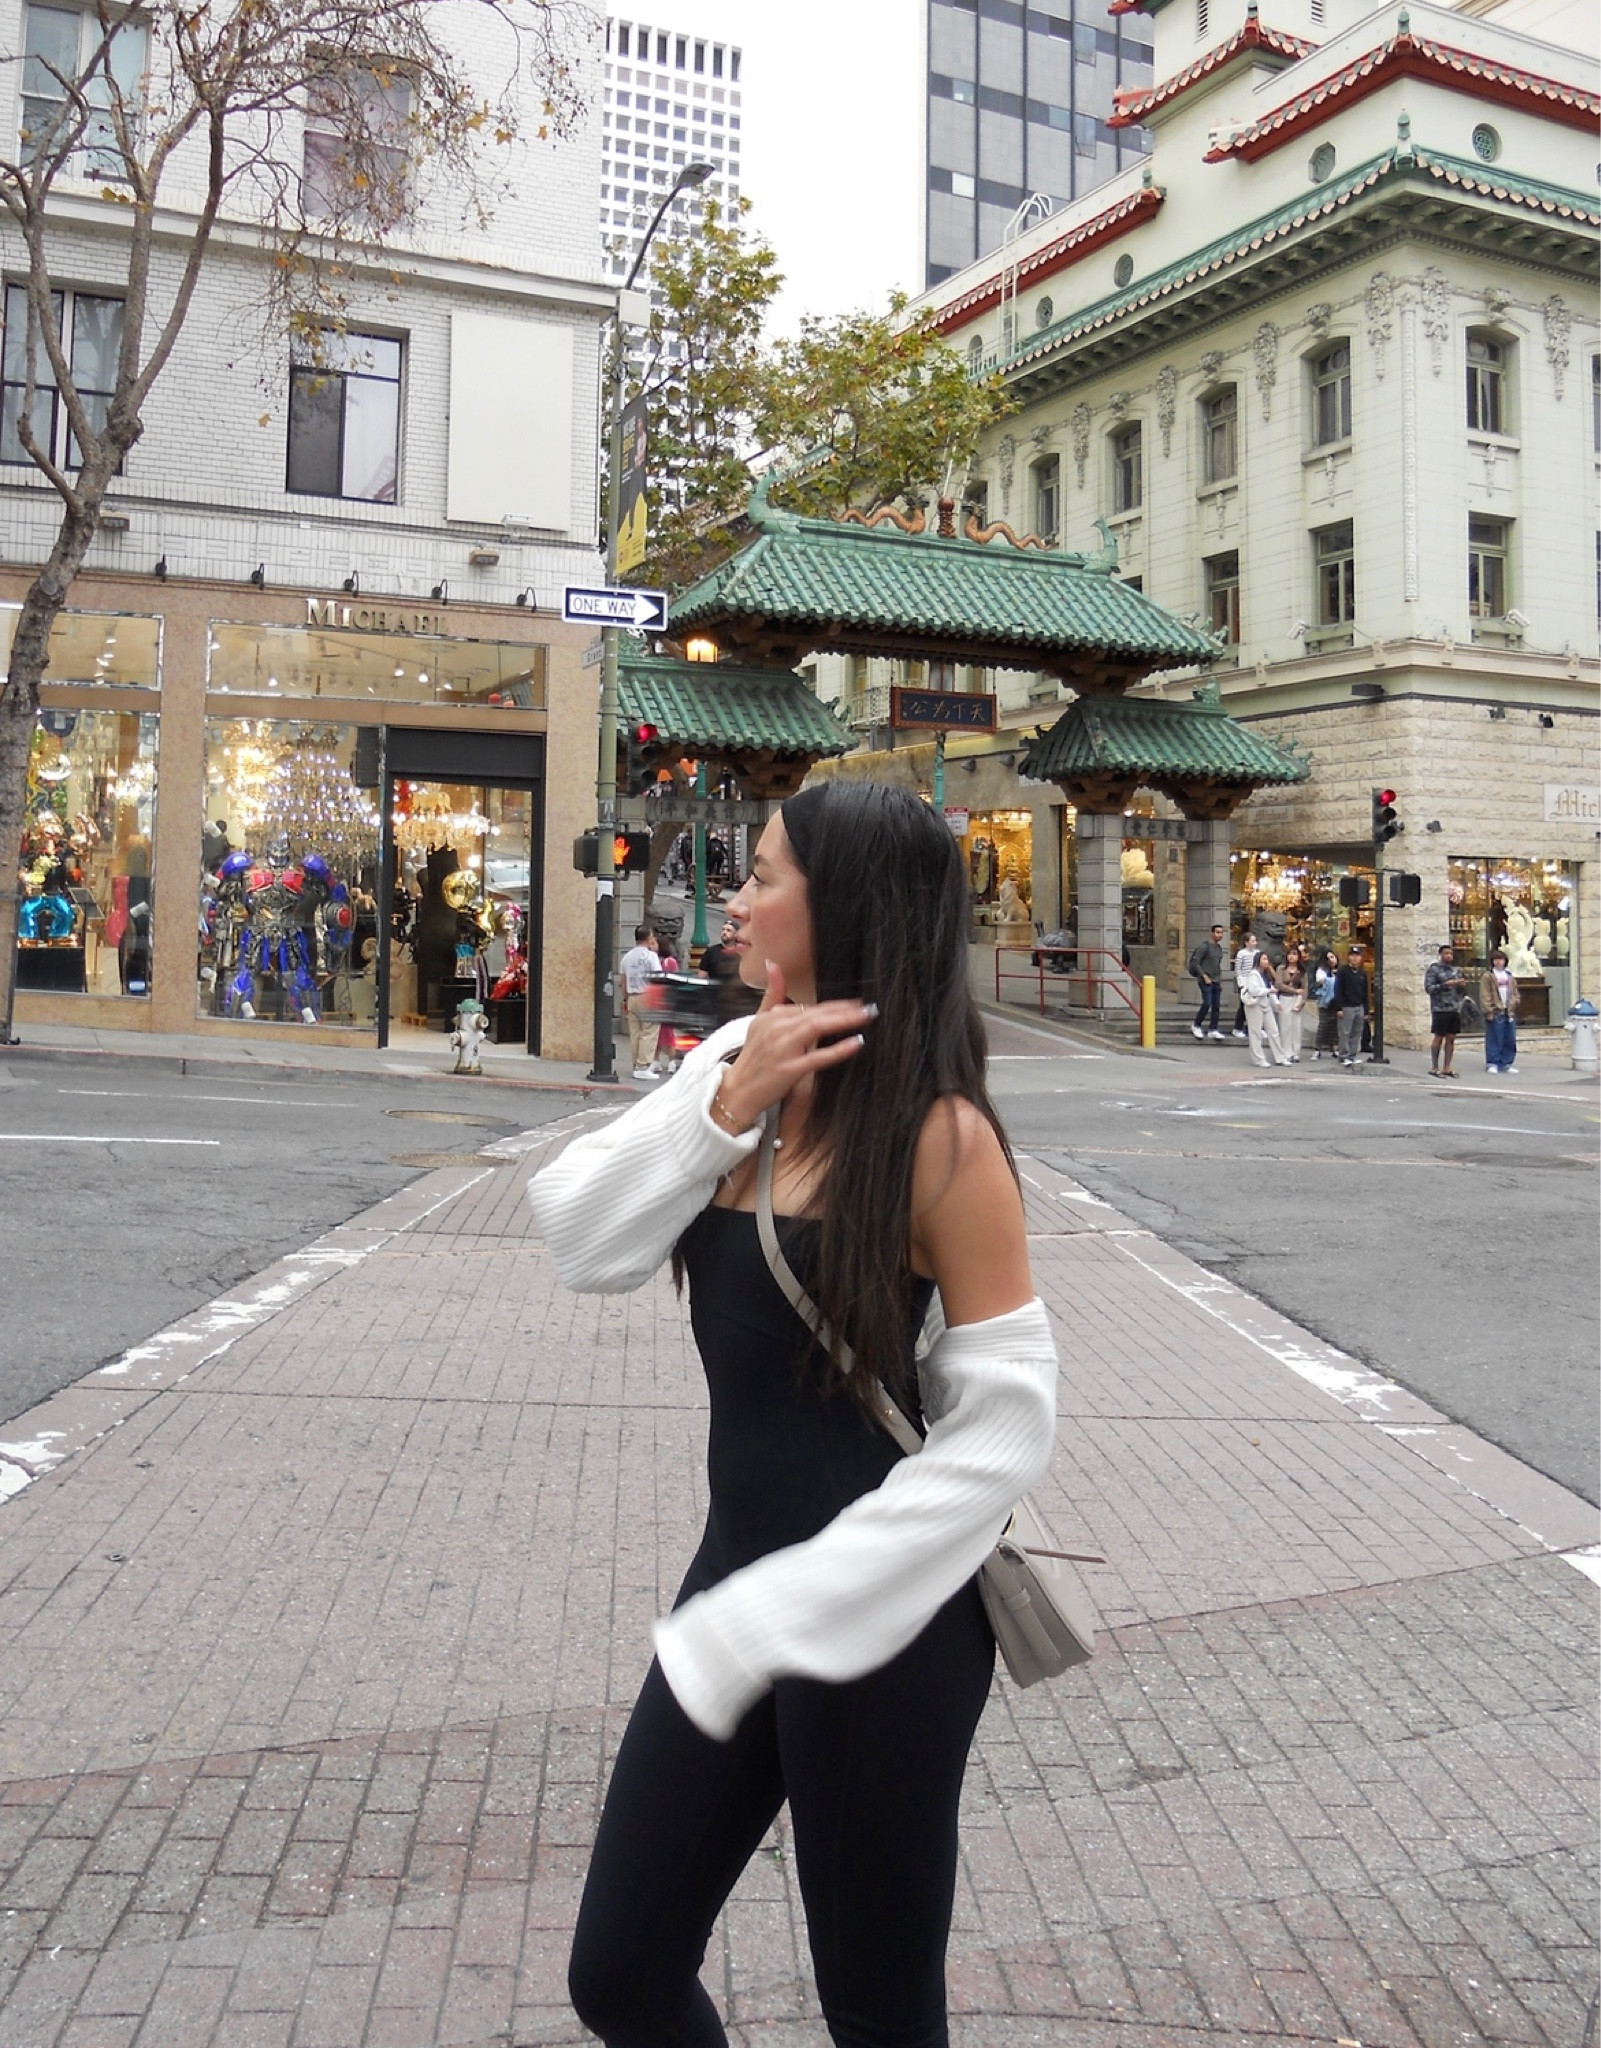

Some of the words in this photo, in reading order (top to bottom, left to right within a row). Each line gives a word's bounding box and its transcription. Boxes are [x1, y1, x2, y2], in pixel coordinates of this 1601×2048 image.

[305, 598, 447, 637] MICHAEL
[573, 597, 602, 614] ONE
[608, 600, 637, 617] WAY
[1550, 789, 1600, 819] Mic
